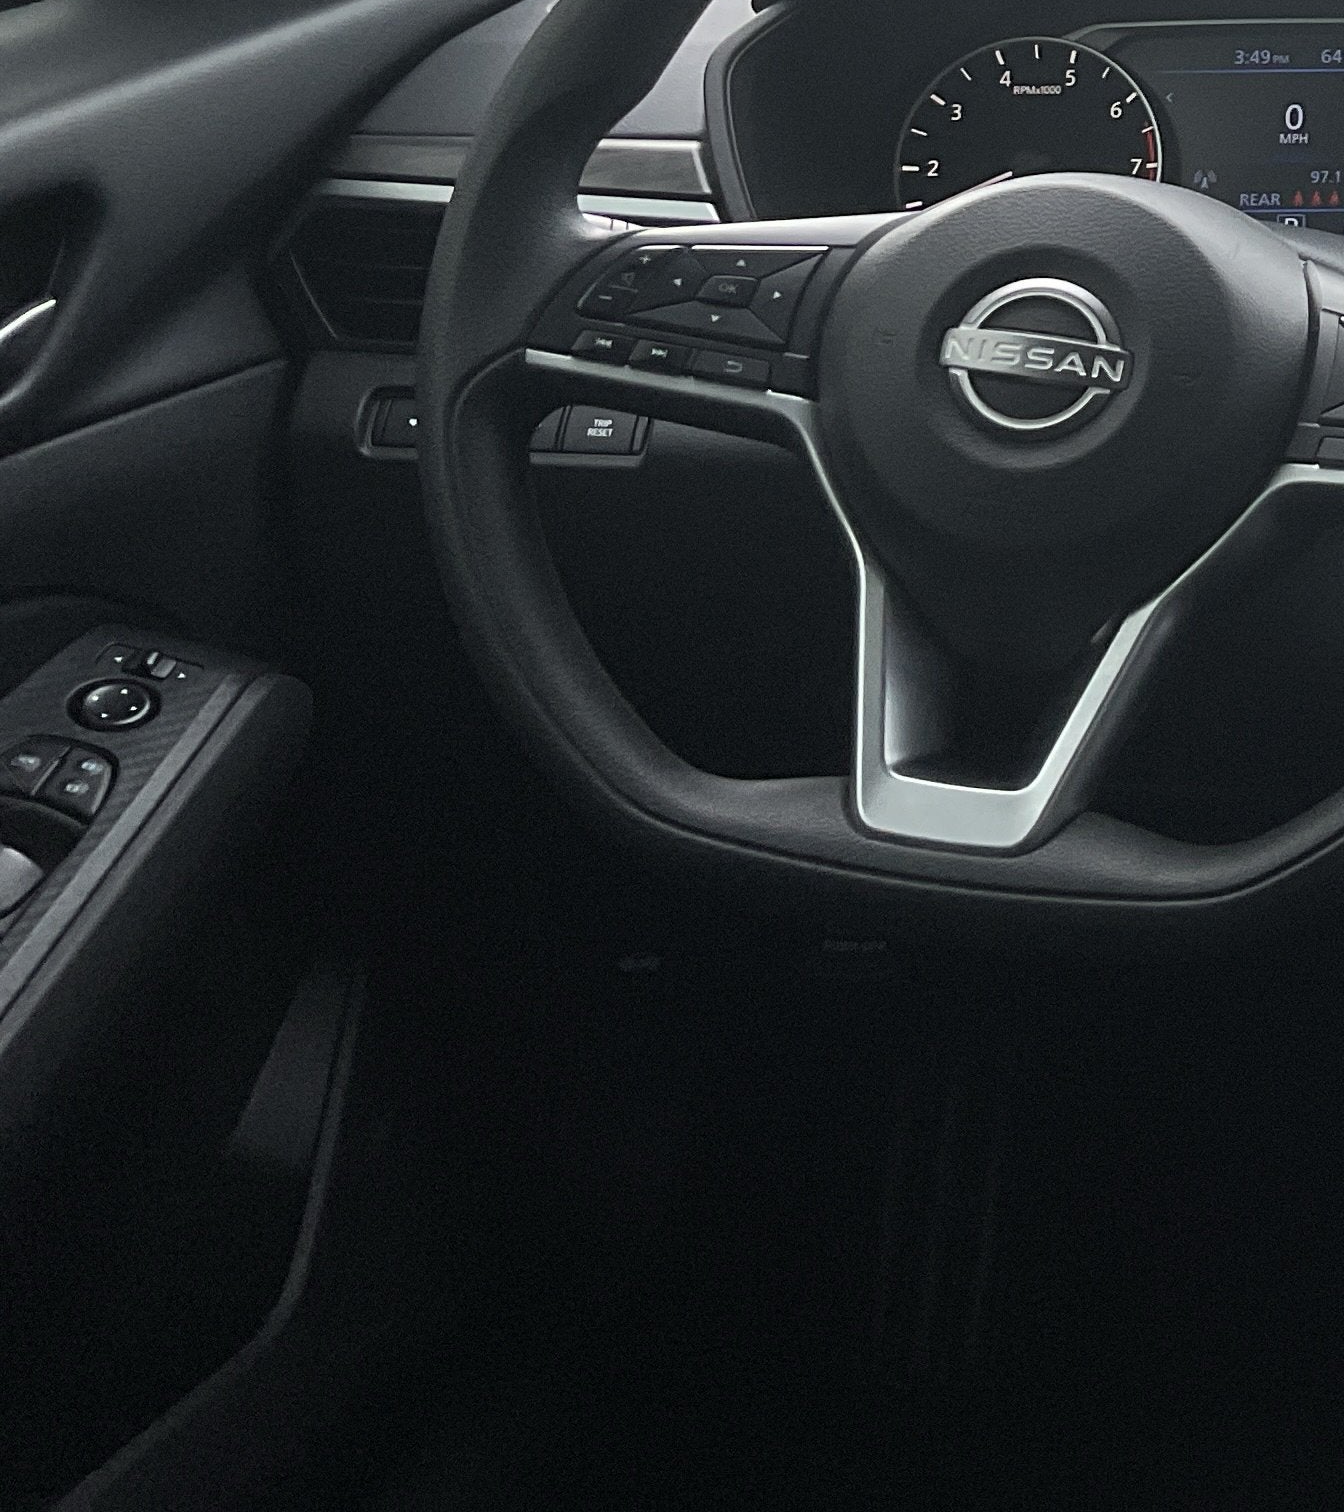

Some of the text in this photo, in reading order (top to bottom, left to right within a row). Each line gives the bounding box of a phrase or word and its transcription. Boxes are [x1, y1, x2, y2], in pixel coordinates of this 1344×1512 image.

[1234, 49, 1271, 65] 3:49
[999, 70, 1011, 87] 4
[1065, 69, 1076, 87] 5
[950, 103, 962, 121] 3
[1110, 101, 1122, 118] 6
[1285, 103, 1304, 131] 0
[1279, 133, 1309, 144] MPH
[927, 159, 939, 177] 2
[1130, 158, 1142, 175] 7
[1310, 170, 1341, 184] 97.1
[1240, 193, 1281, 207] REAR
[944, 338, 1125, 382] NISSAN
[594, 418, 613, 427] TRIP
[587, 427, 614, 437] RESET
